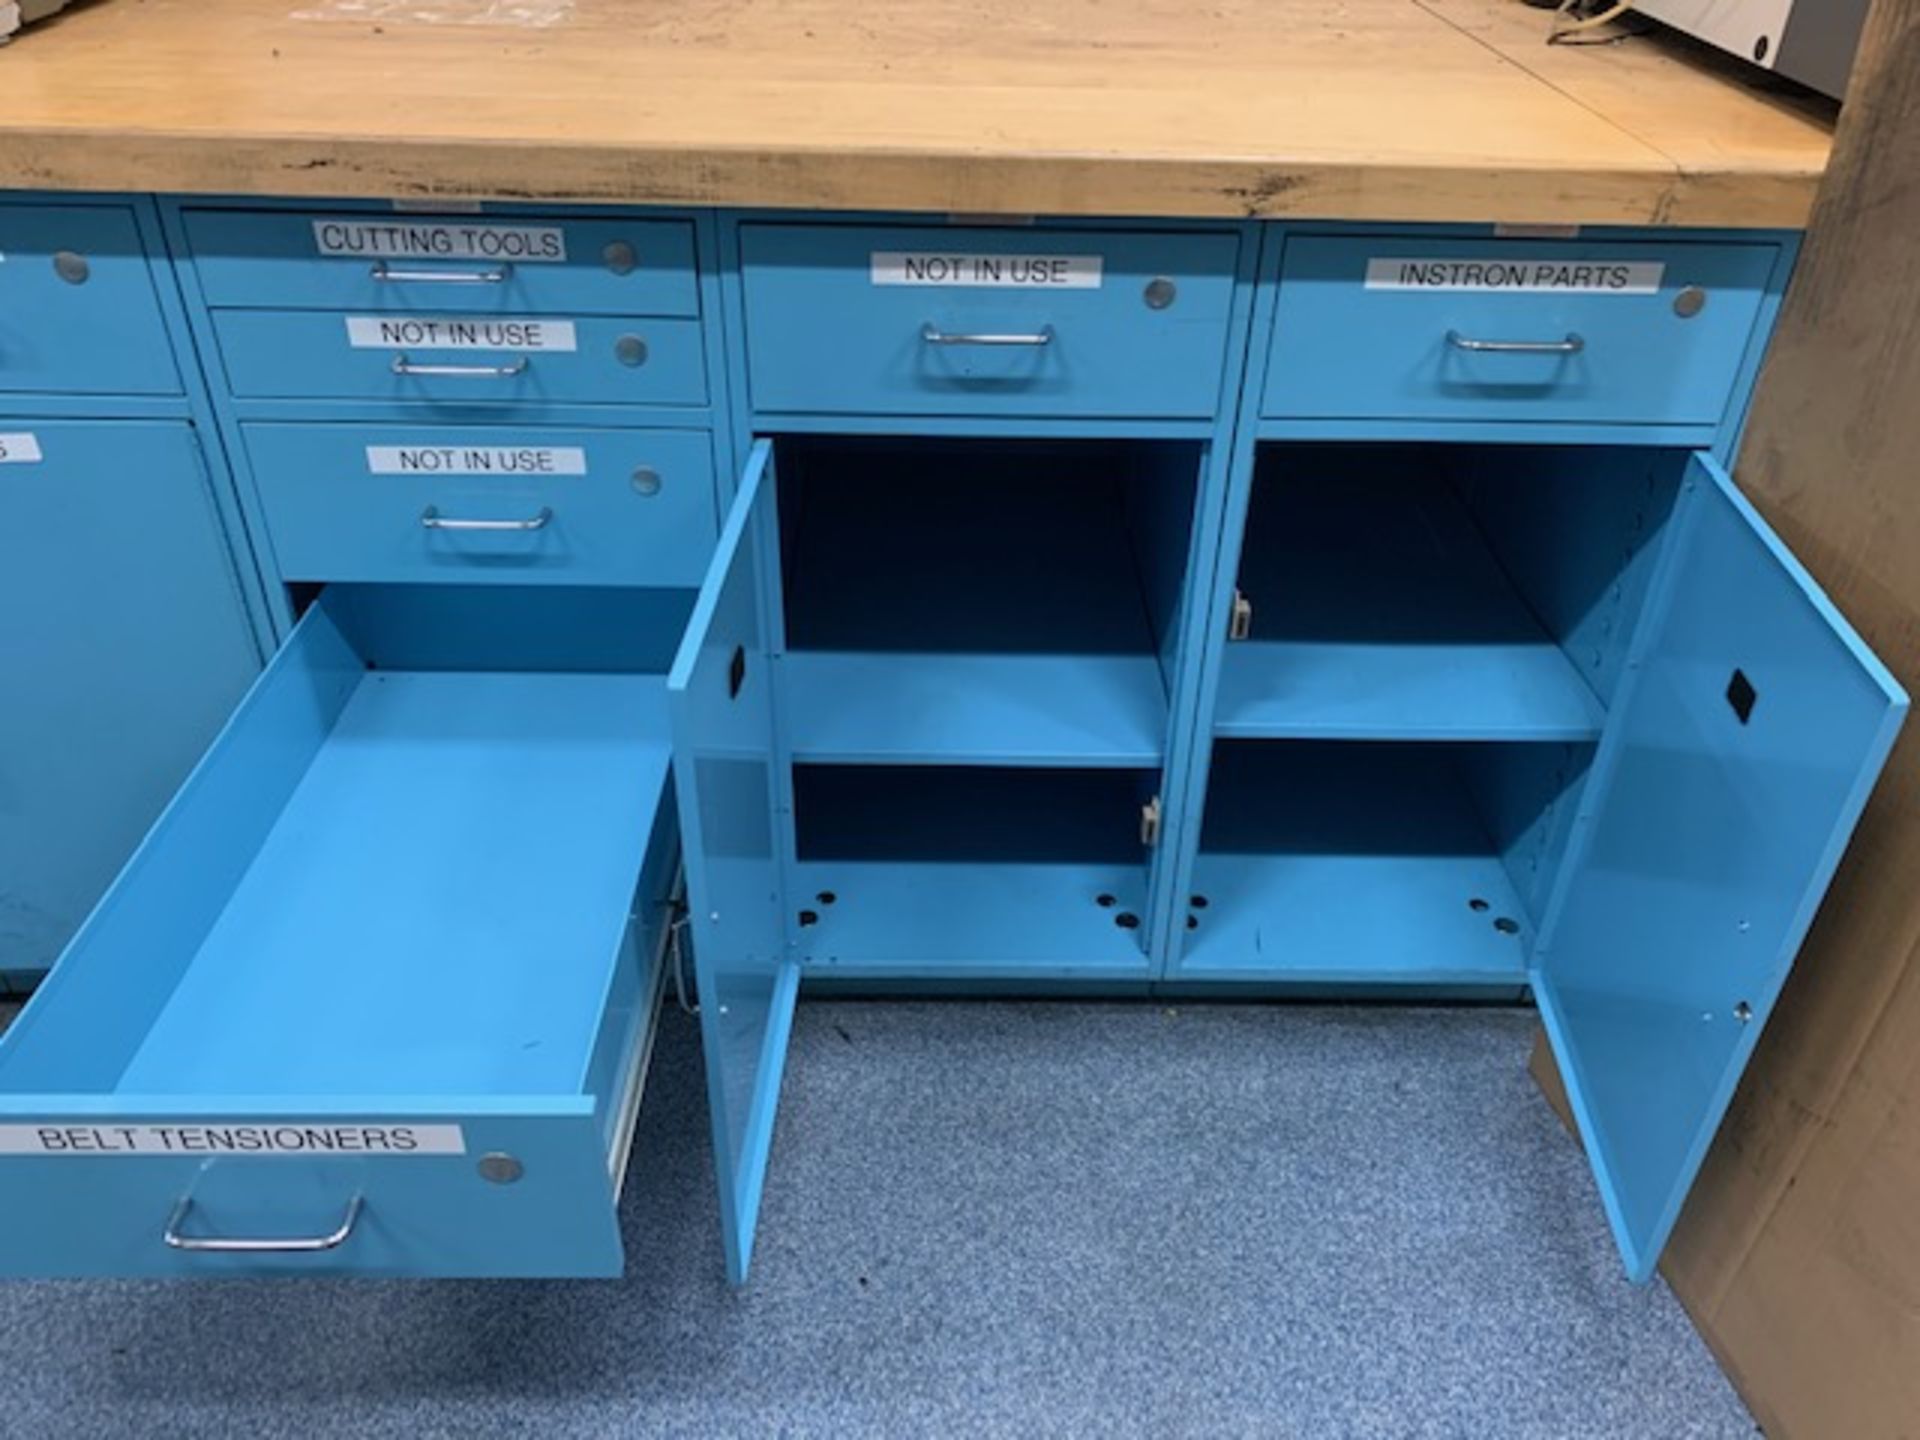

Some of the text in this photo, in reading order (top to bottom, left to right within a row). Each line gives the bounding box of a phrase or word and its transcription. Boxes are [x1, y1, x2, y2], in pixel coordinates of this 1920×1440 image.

[321, 224, 560, 257] CUTTING TOOLS
[905, 257, 1070, 284] NOT IN USE
[1399, 262, 1631, 289] INSTRON PARTS
[380, 322, 544, 346] NOT IN USE
[399, 449, 554, 472] NOT IN USE
[37, 1127, 419, 1152] BELT TENSIONERS
